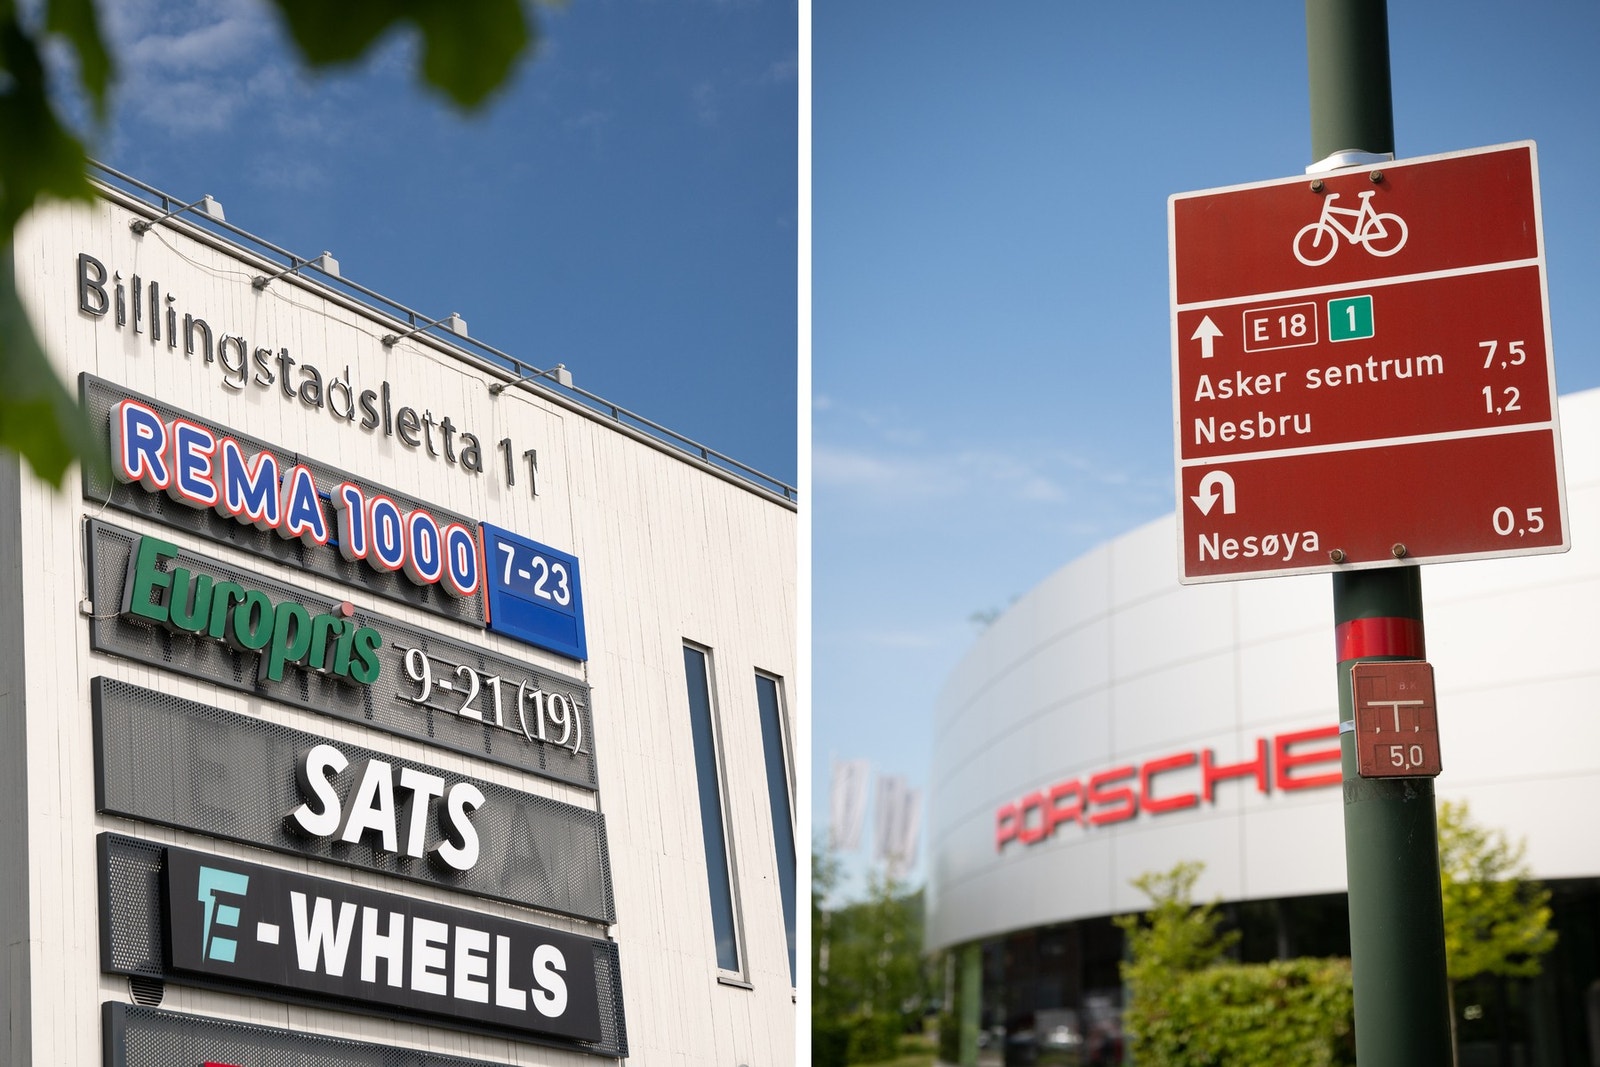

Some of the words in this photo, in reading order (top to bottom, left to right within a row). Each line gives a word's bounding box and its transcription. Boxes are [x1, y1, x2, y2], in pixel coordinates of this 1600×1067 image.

[1254, 317, 1269, 342] E
[1278, 313, 1307, 339] 18
[1345, 305, 1356, 332] 1
[78, 253, 484, 474] Billingstadsletta
[499, 438, 538, 497] 11
[1194, 370, 1287, 402] Asker
[1305, 353, 1444, 389] sentrum
[1478, 340, 1527, 371] 7,5
[1194, 412, 1312, 446] Nesbru
[1481, 386, 1522, 416] 1,2
[113, 399, 329, 549] REMA
[333, 481, 478, 598] 1000
[1198, 530, 1320, 563] Nesøya
[1492, 506, 1545, 538] 0,5
[125, 535, 383, 685] Europris
[497, 541, 571, 607] 7-23
[405, 648, 504, 728] 9-21
[518, 678, 582, 756] (19)
[995, 725, 1342, 853] PORSCHE
[1389, 745, 1423, 771] 5,0
[289, 744, 487, 871] SATS
[197, 865, 569, 1018] E-WHEELS
